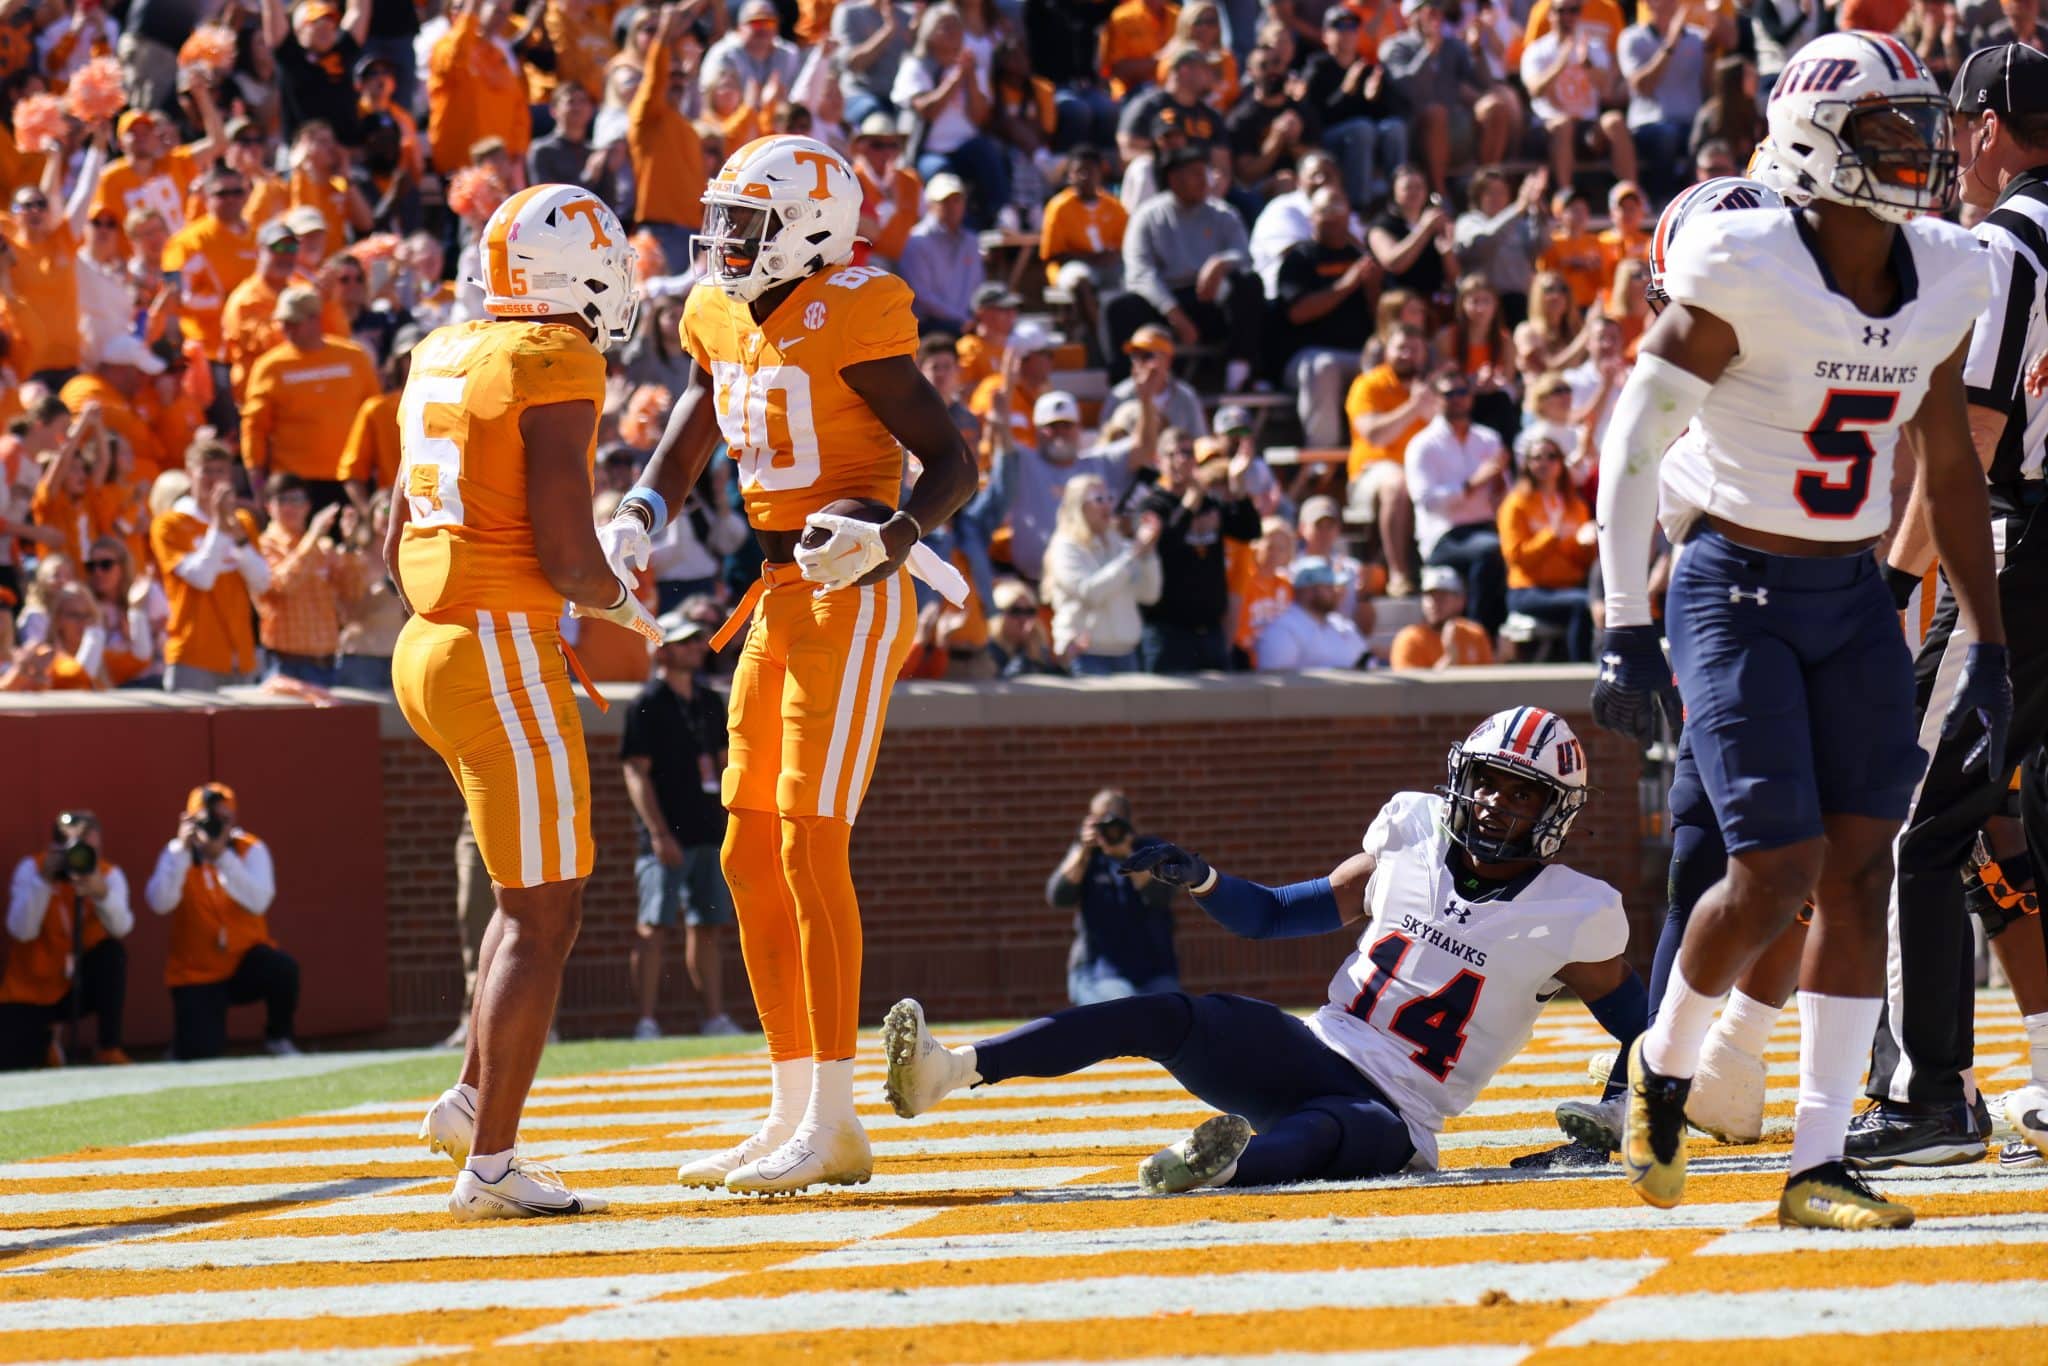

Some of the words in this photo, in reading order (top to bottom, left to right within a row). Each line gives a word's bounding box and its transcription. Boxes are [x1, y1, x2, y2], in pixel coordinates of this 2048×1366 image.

[1977, 88, 1988, 103] S
[793, 151, 842, 200] T
[560, 199, 612, 250] T
[511, 268, 528, 296] 5
[803, 302, 828, 330] SEC
[1814, 361, 1918, 384] SKYHAWKS
[403, 376, 468, 527] 5
[710, 361, 822, 491] 80
[1793, 387, 1901, 520] 5
[1401, 914, 1488, 968] SKYHAWKS
[1343, 930, 1487, 1083] 14
